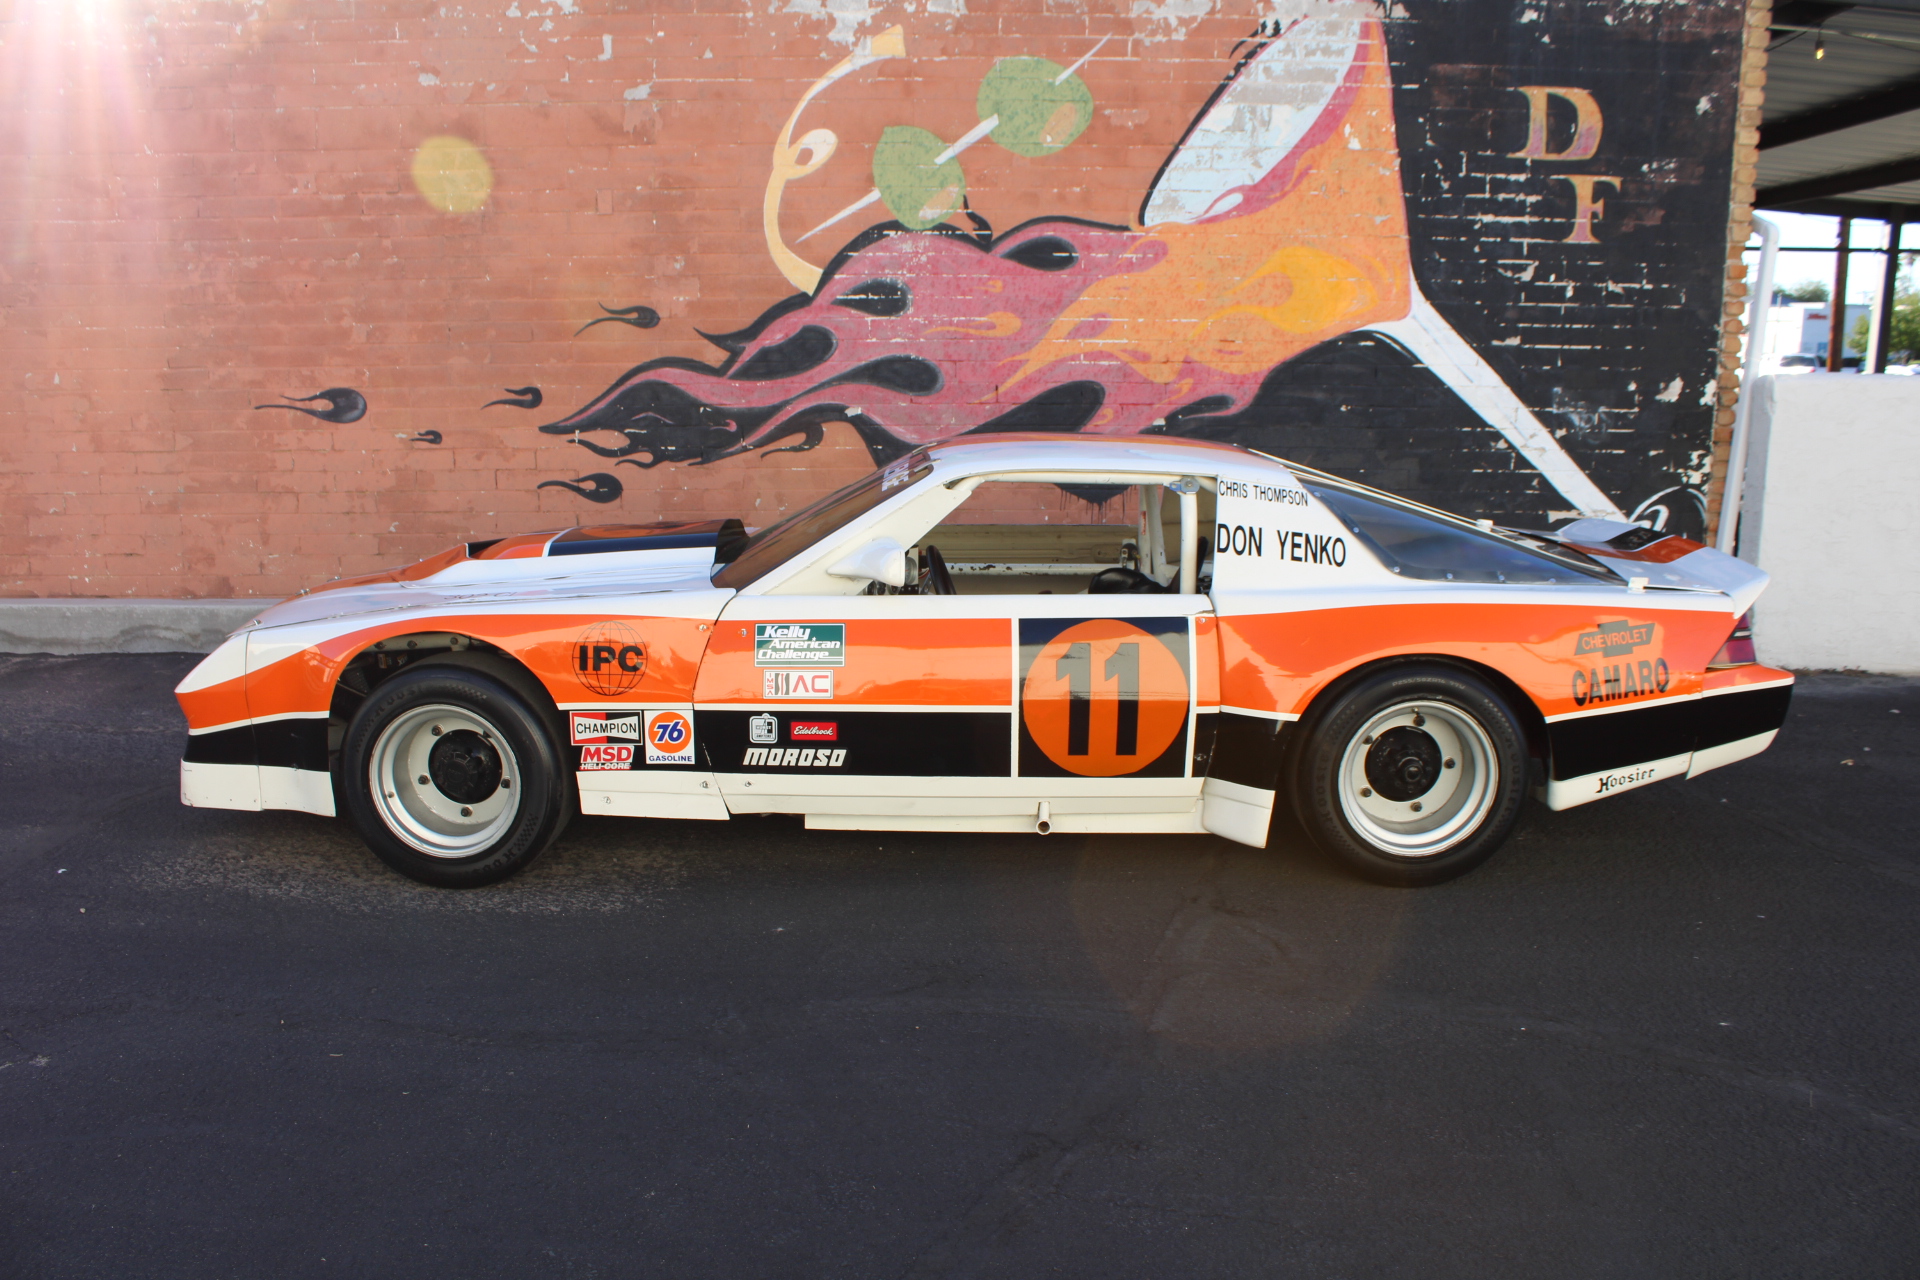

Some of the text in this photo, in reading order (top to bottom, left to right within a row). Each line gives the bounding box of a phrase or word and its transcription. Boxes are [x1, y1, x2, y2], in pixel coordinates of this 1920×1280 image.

[1506, 85, 1603, 160] D
[1562, 174, 1622, 243] F
[1218, 480, 1308, 506] CHRIS THOMPSON
[1217, 523, 1346, 567] DON YENKO
[763, 625, 811, 640] Kelly
[769, 637, 840, 649] American
[1582, 628, 1648, 650] CHEVROLET
[579, 645, 644, 672] IPC
[757, 649, 829, 660] Challenge
[766, 672, 774, 696] IMSA
[1572, 657, 1669, 706] CAMARO
[1056, 643, 1139, 755] 11
[576, 722, 637, 734] CHAMPION
[654, 719, 685, 744] 76
[793, 725, 834, 736] Edelbrock
[581, 762, 631, 770] HELI-CORE
[582, 746, 632, 762] MSD
[742, 748, 847, 766] MOROSO
[1595, 768, 1655, 793] Hoosier
